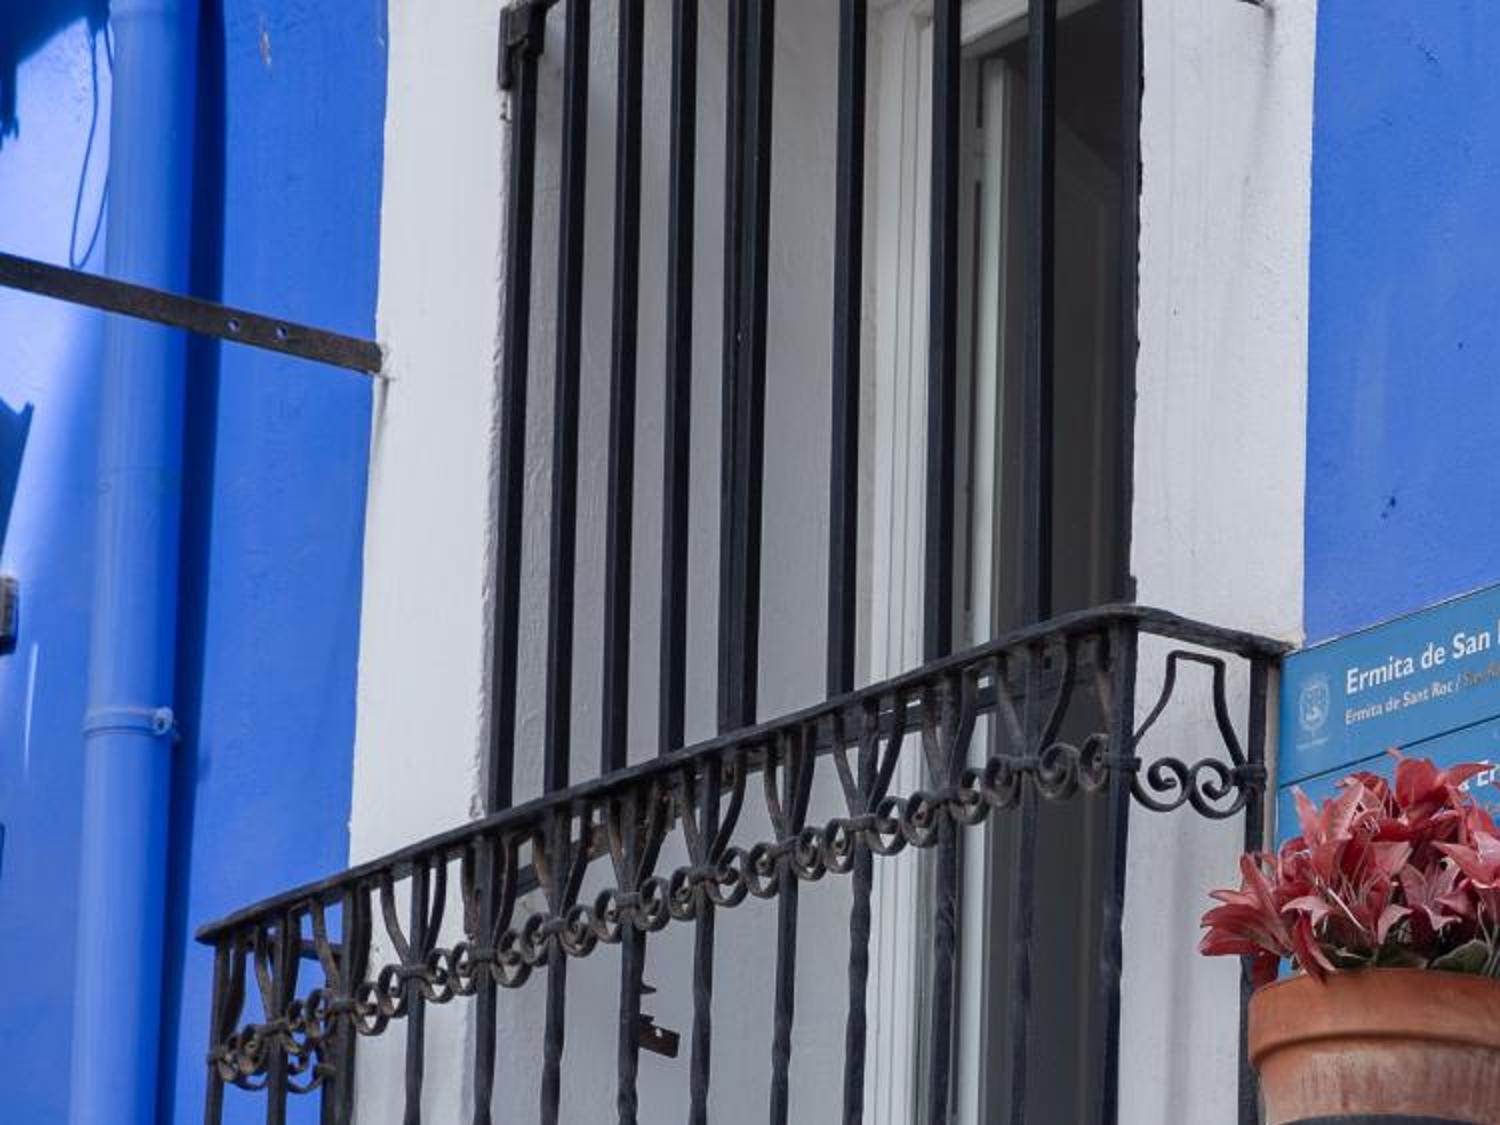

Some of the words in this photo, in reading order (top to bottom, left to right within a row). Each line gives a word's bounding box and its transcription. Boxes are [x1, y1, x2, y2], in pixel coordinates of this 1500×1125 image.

[1345, 656, 1415, 695] Ermita
[1420, 641, 1446, 669] de
[1452, 631, 1491, 659] San
[1344, 702, 1383, 726] Ermita
